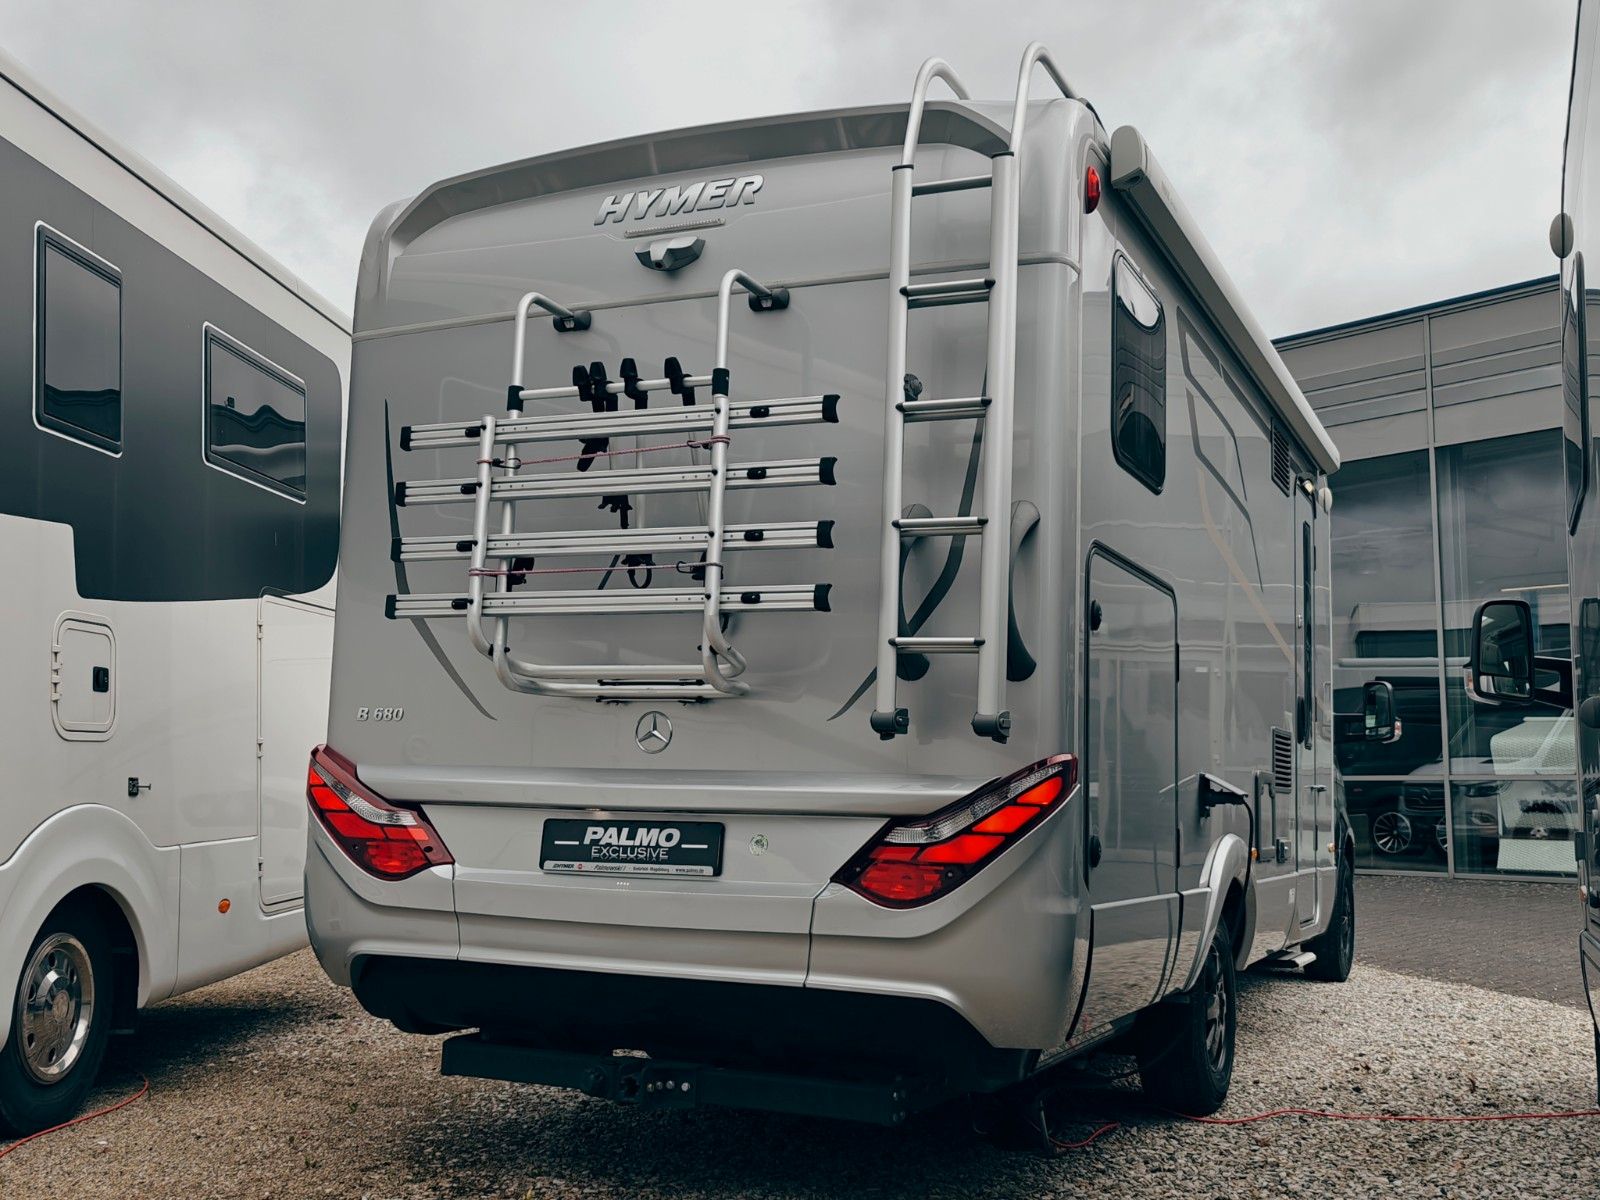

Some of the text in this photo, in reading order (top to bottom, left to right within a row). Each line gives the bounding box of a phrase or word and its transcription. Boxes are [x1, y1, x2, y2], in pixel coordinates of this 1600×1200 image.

[594, 175, 764, 226] HYMER
[357, 706, 404, 721] B 680
[583, 826, 681, 848] PALMO
[591, 846, 669, 858] EXCLUSIVE
